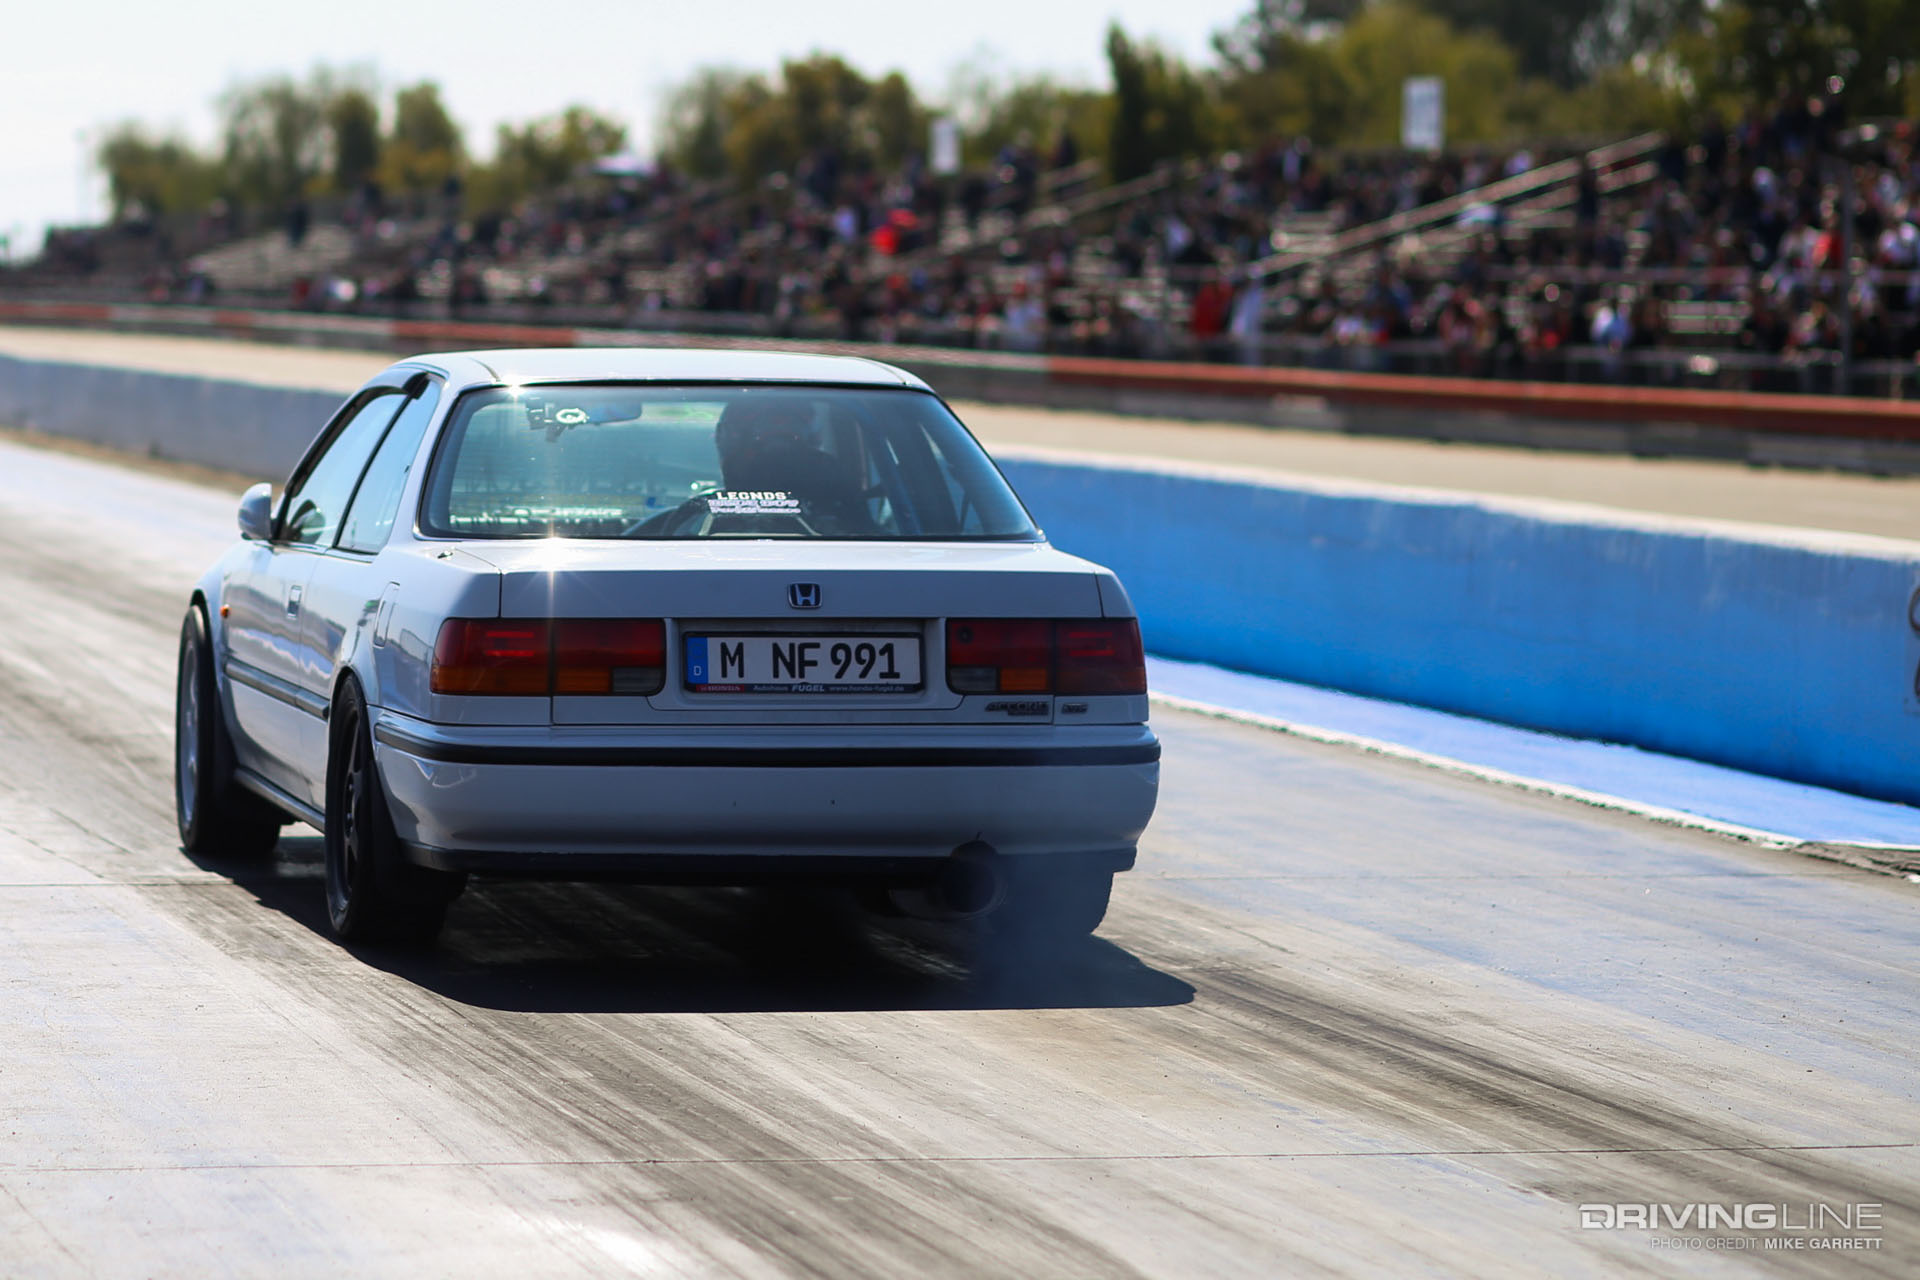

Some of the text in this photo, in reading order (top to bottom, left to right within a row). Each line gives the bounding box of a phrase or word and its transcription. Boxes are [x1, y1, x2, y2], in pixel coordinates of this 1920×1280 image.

[720, 642, 900, 679] M NF 991
